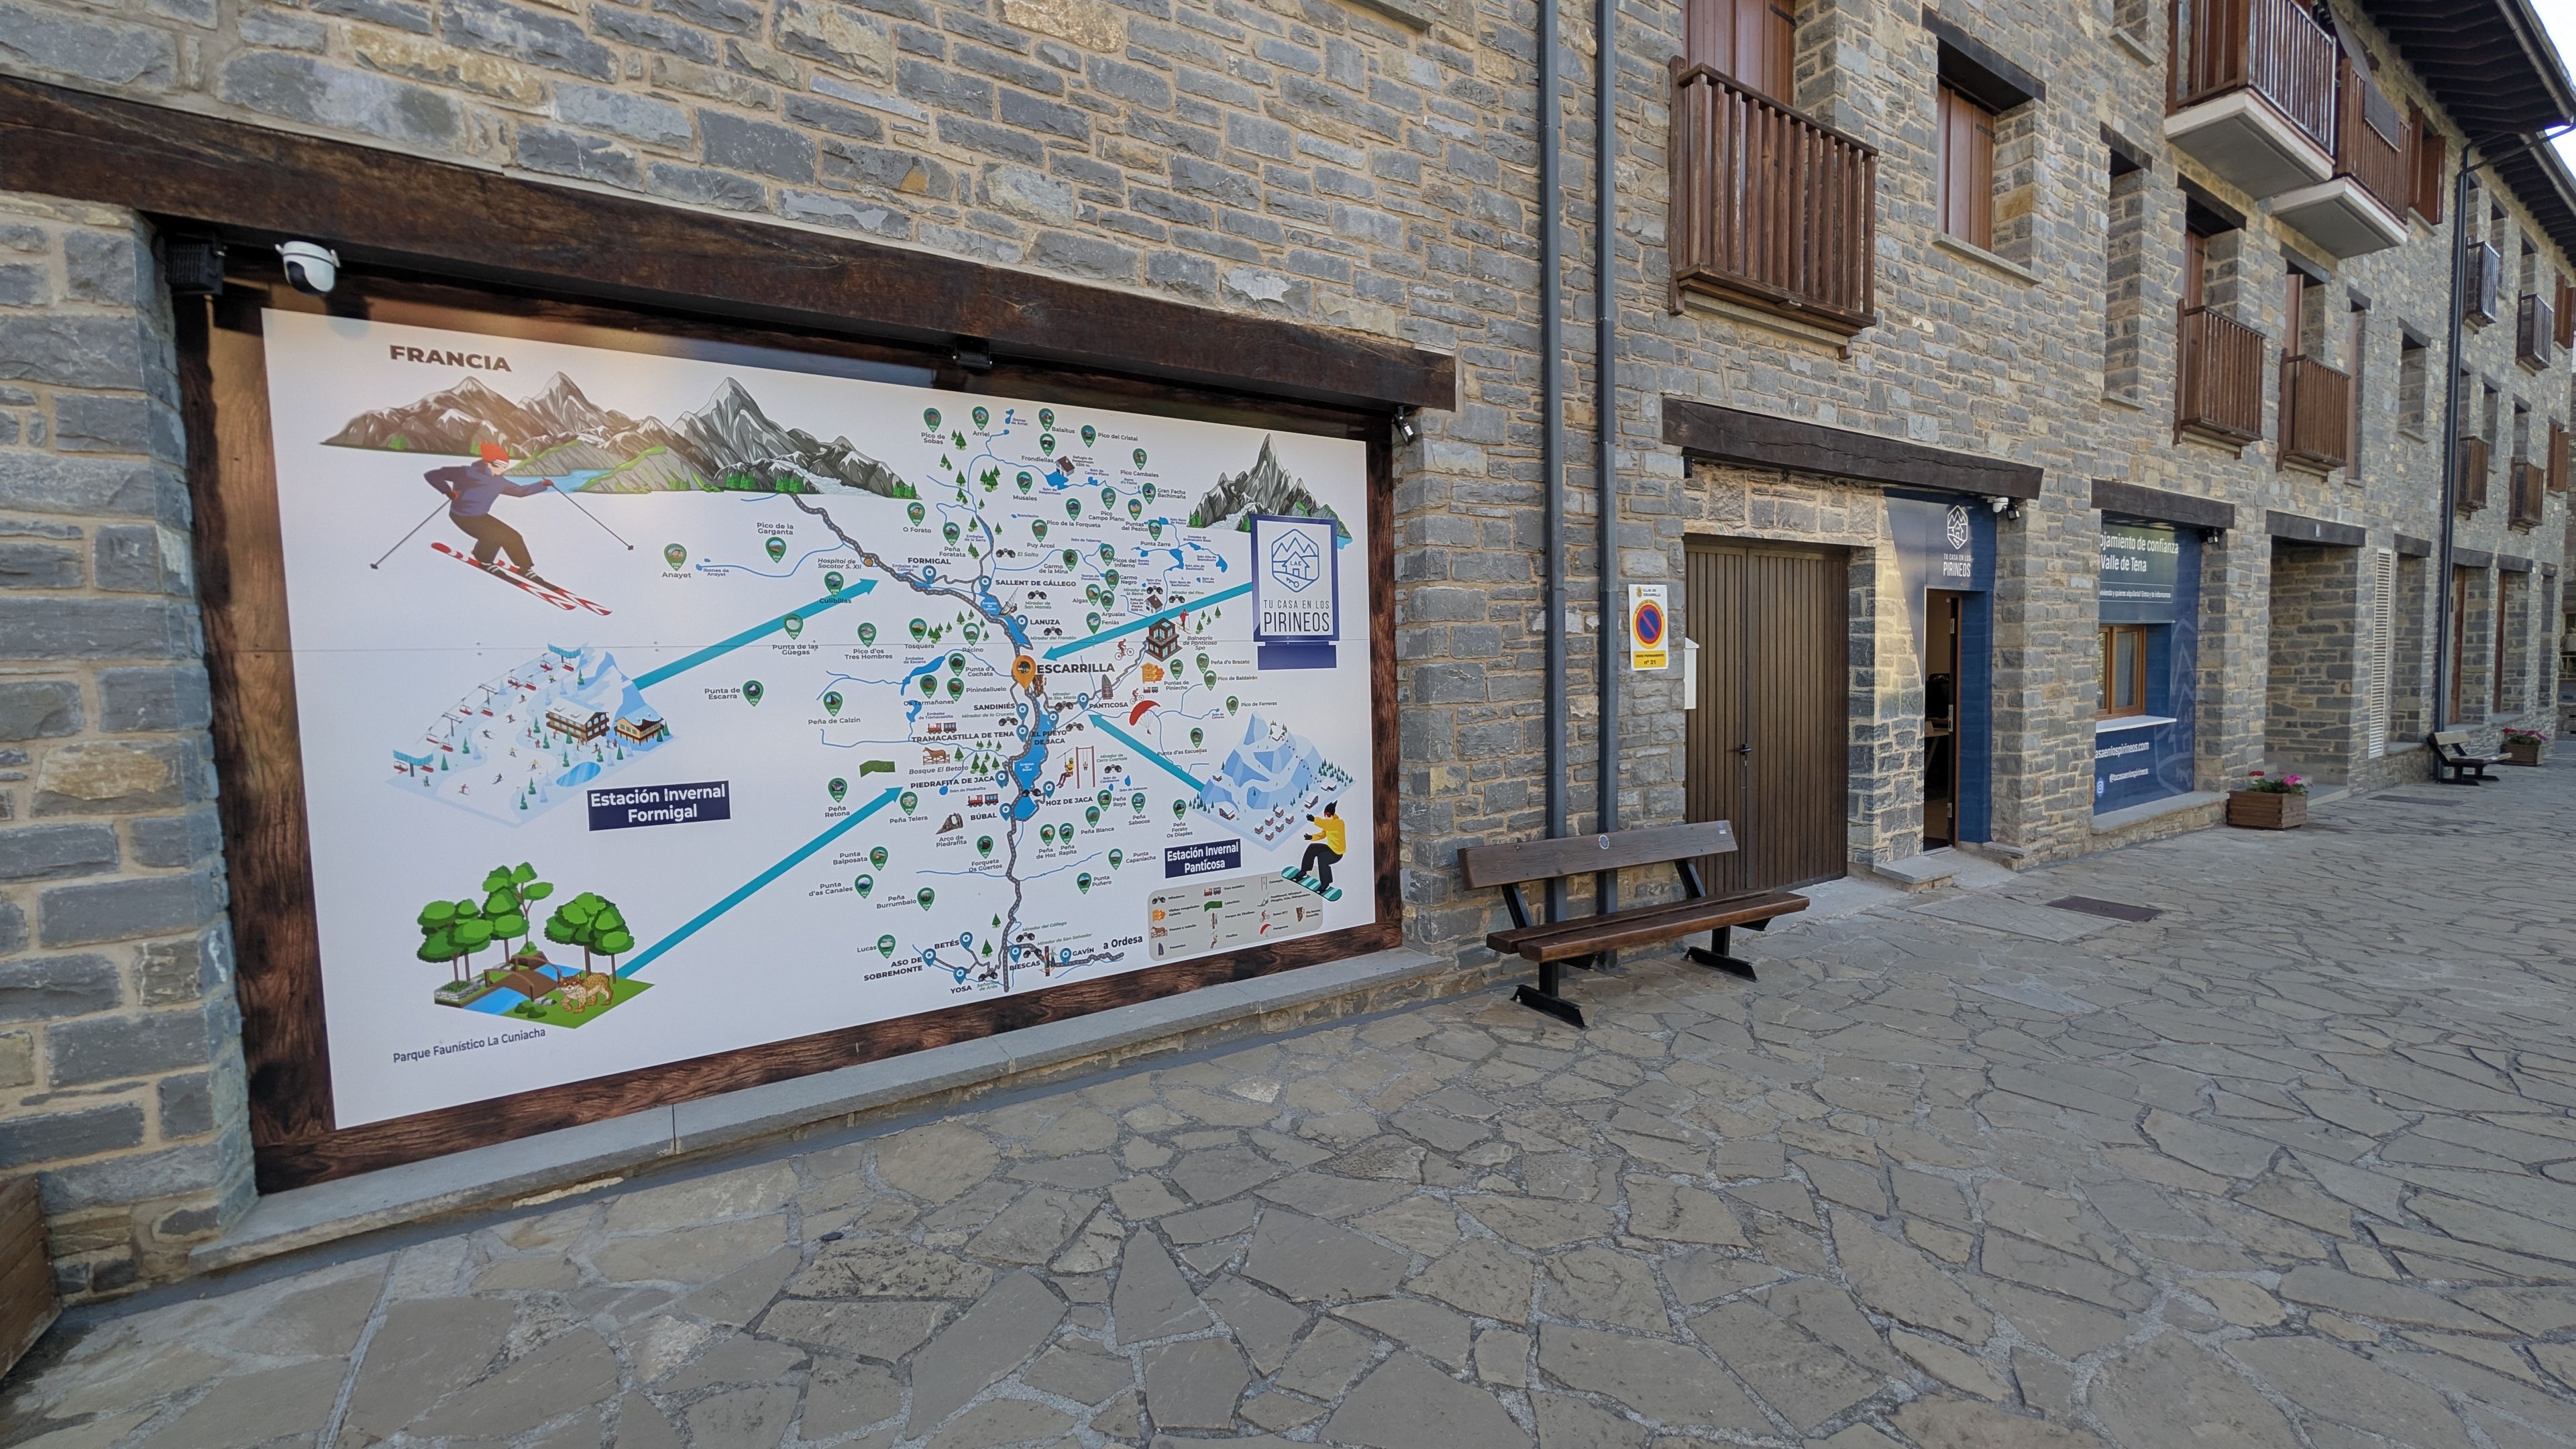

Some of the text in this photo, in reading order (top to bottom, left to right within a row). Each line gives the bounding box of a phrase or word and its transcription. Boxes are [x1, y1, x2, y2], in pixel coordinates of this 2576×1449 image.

[390, 345, 512, 372] FRANCIA
[2137, 537, 2146, 551] de
[2147, 538, 2178, 554] confianza
[2101, 554, 2147, 572] Valle de Tena
[1943, 562, 1970, 577] PIRINEOS
[1264, 600, 1330, 608] TU CASA EN LOS
[1265, 612, 1330, 632] PIRINEOS
[1036, 663, 1116, 674] ESCARRILLA
[912, 733, 979, 742] TRAMACASTILLA
[910, 780, 959, 788] PIEDRAFITA
[591, 784, 725, 807] Estación Invernal
[629, 804, 697, 822] Formigal
[970, 812, 997, 820] BÚBAL
[1167, 842, 1238, 862] Estación Invernal
[833, 856, 867, 865] Balposata
[1184, 859, 1225, 873] Panticosa
[825, 886, 853, 894] Canales
[877, 899, 916, 909] Burrumbalo
[934, 939, 959, 949] BETÉS
[1104, 936, 1143, 949] a Ordesa
[1073, 947, 1094, 957] GAVÍN
[891, 959, 909, 967] ASO
[1009, 961, 1040, 971] BIESCAS
[864, 965, 923, 981] SOBREMONTE
[951, 985, 972, 994] YOSA
[394, 1028, 546, 1063] Parque Faunístico La Cuniacha
